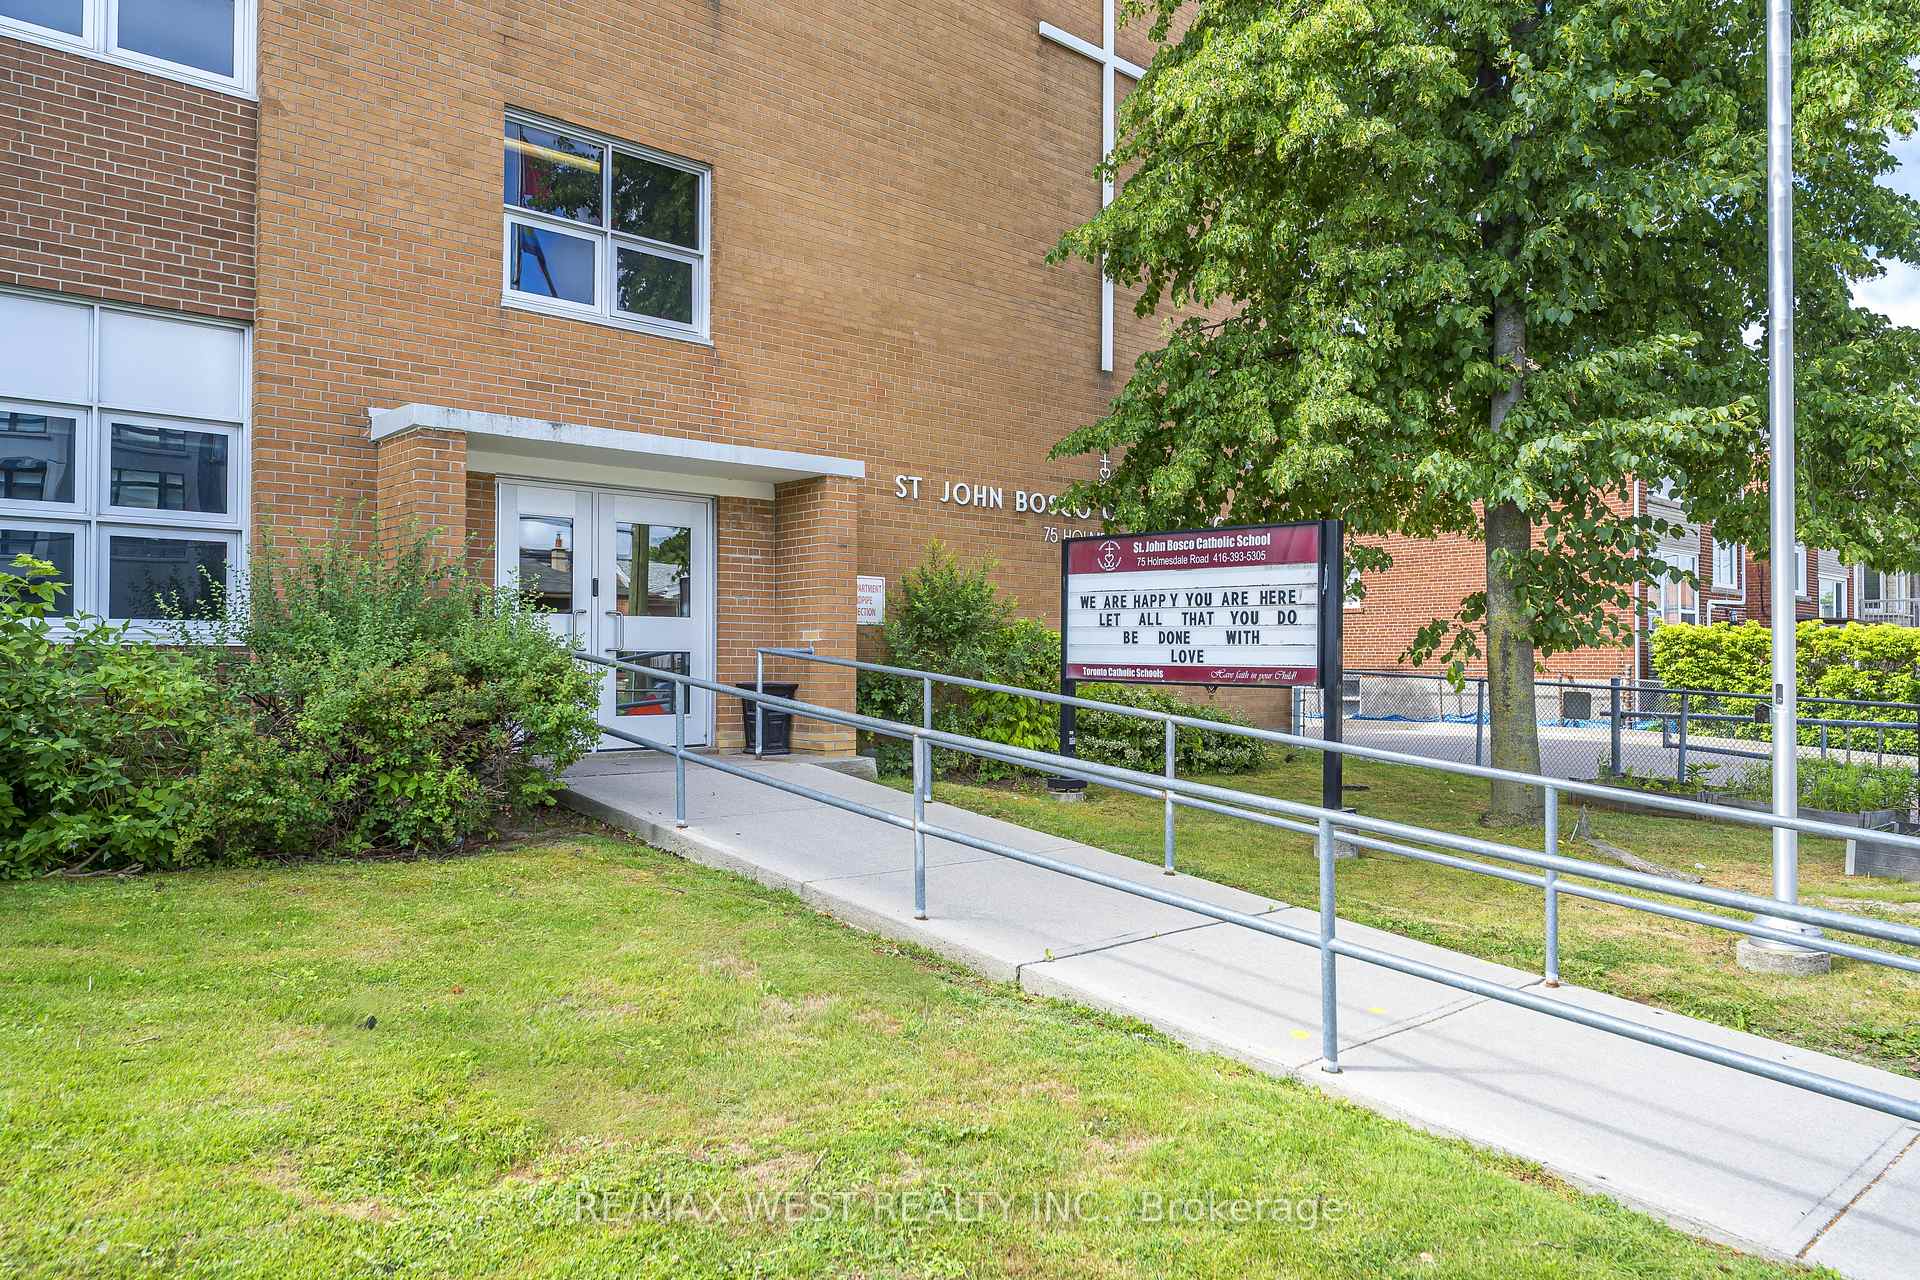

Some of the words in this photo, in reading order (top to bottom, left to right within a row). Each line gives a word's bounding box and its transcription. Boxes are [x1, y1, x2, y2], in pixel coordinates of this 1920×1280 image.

[895, 475, 922, 499] ST
[940, 481, 1003, 509] JOHN
[1044, 526, 1058, 543] 75
[1133, 541, 1145, 554] St.
[1146, 540, 1166, 552] John
[1167, 538, 1195, 551] Bosco
[1196, 535, 1236, 550] Catholic
[1237, 532, 1271, 547] School
[1137, 557, 1146, 567] 75
[1147, 554, 1188, 566] Holmesdale
[1189, 554, 1209, 565] Road
[1213, 550, 1266, 563] 416-393-5305
[1080, 595, 1096, 609] WE
[1103, 595, 1127, 609] ARE
[1133, 593, 1178, 609] HAPPY
[1185, 592, 1213, 606] YOU
[1221, 591, 1249, 606] ARE
[1259, 589, 1297, 605] HERE
[1099, 612, 1121, 626] LET
[1138, 611, 1163, 626] ALL
[1181, 611, 1214, 626] THAT
[1230, 610, 1259, 625] YOU
[1277, 609, 1298, 625] DO
[1123, 631, 1139, 644] BE
[1158, 630, 1191, 645] DONE
[1225, 629, 1260, 645] WITH
[1170, 648, 1204, 664] LOVE
[1082, 666, 1107, 676] Toronto
[1108, 666, 1136, 677] Catholic
[1136, 668, 1164, 678] Schools
[1209, 668, 1233, 680] Have
[1232, 670, 1249, 682] faith
[1250, 671, 1258, 680] in
[1257, 672, 1273, 682] your
